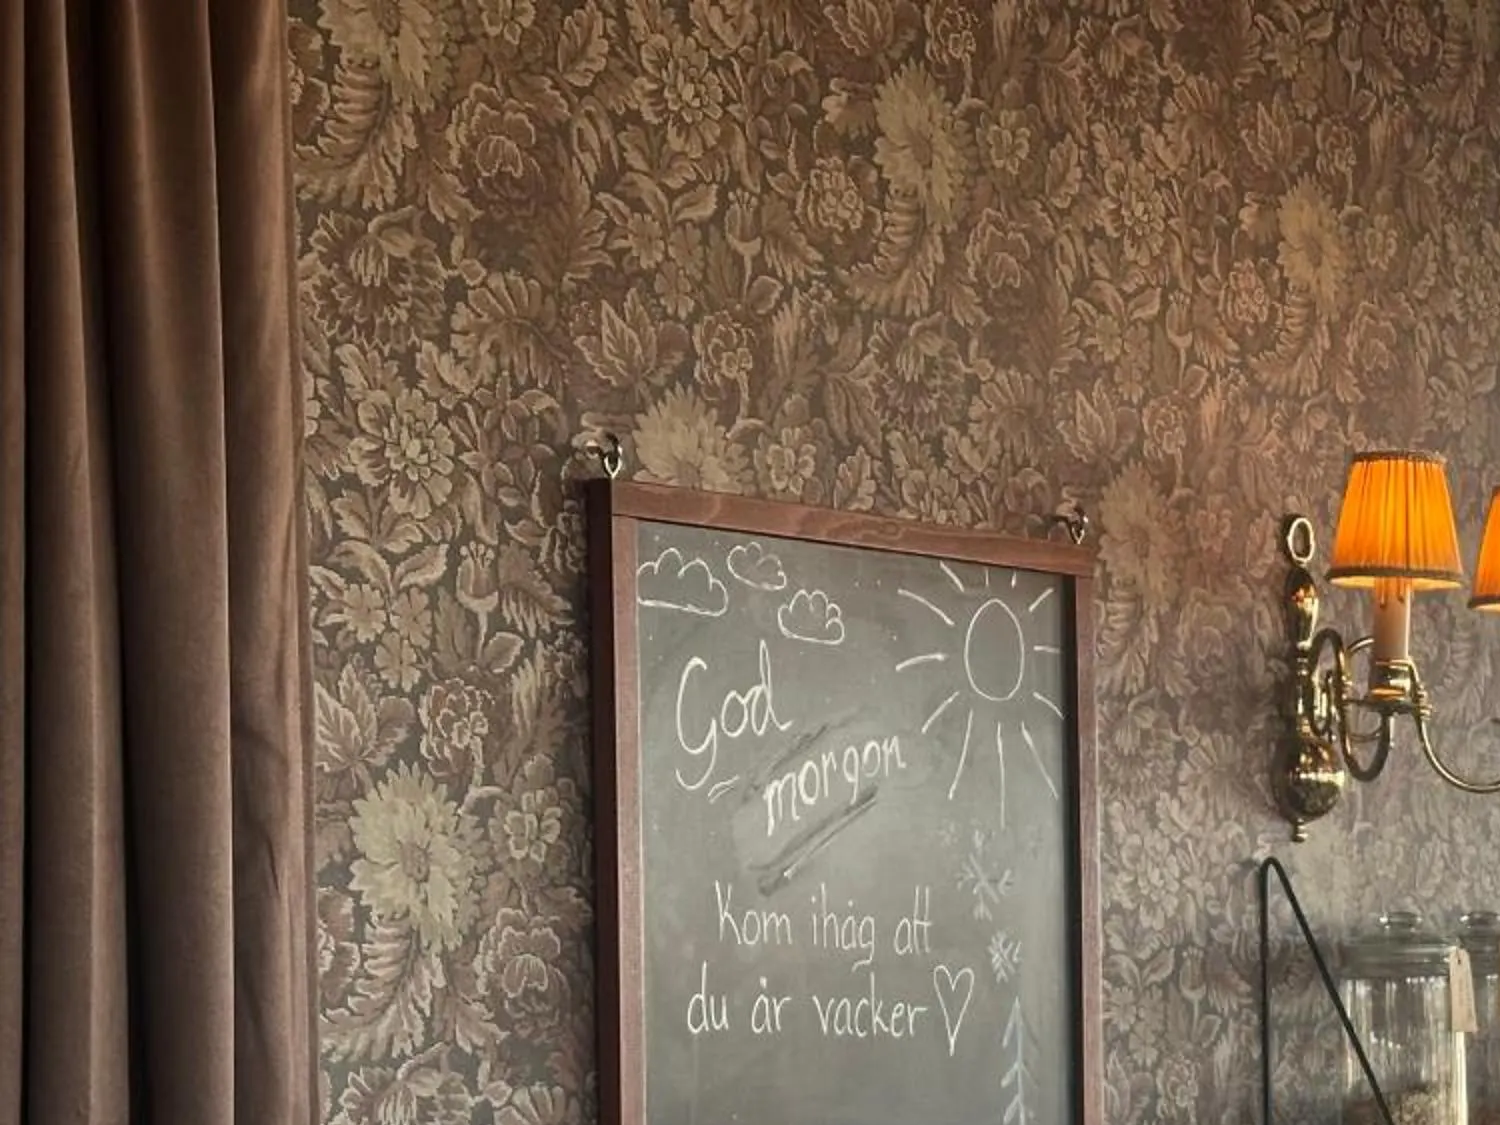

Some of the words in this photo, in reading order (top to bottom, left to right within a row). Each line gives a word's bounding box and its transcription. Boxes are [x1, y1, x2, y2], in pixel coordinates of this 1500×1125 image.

[675, 639, 793, 790] God
[762, 735, 907, 836] morgon
[714, 879, 793, 945] Kom
[810, 882, 875, 972] ihåg
[893, 885, 934, 956] att
[687, 960, 729, 1034] du
[811, 971, 928, 1037] vacker
